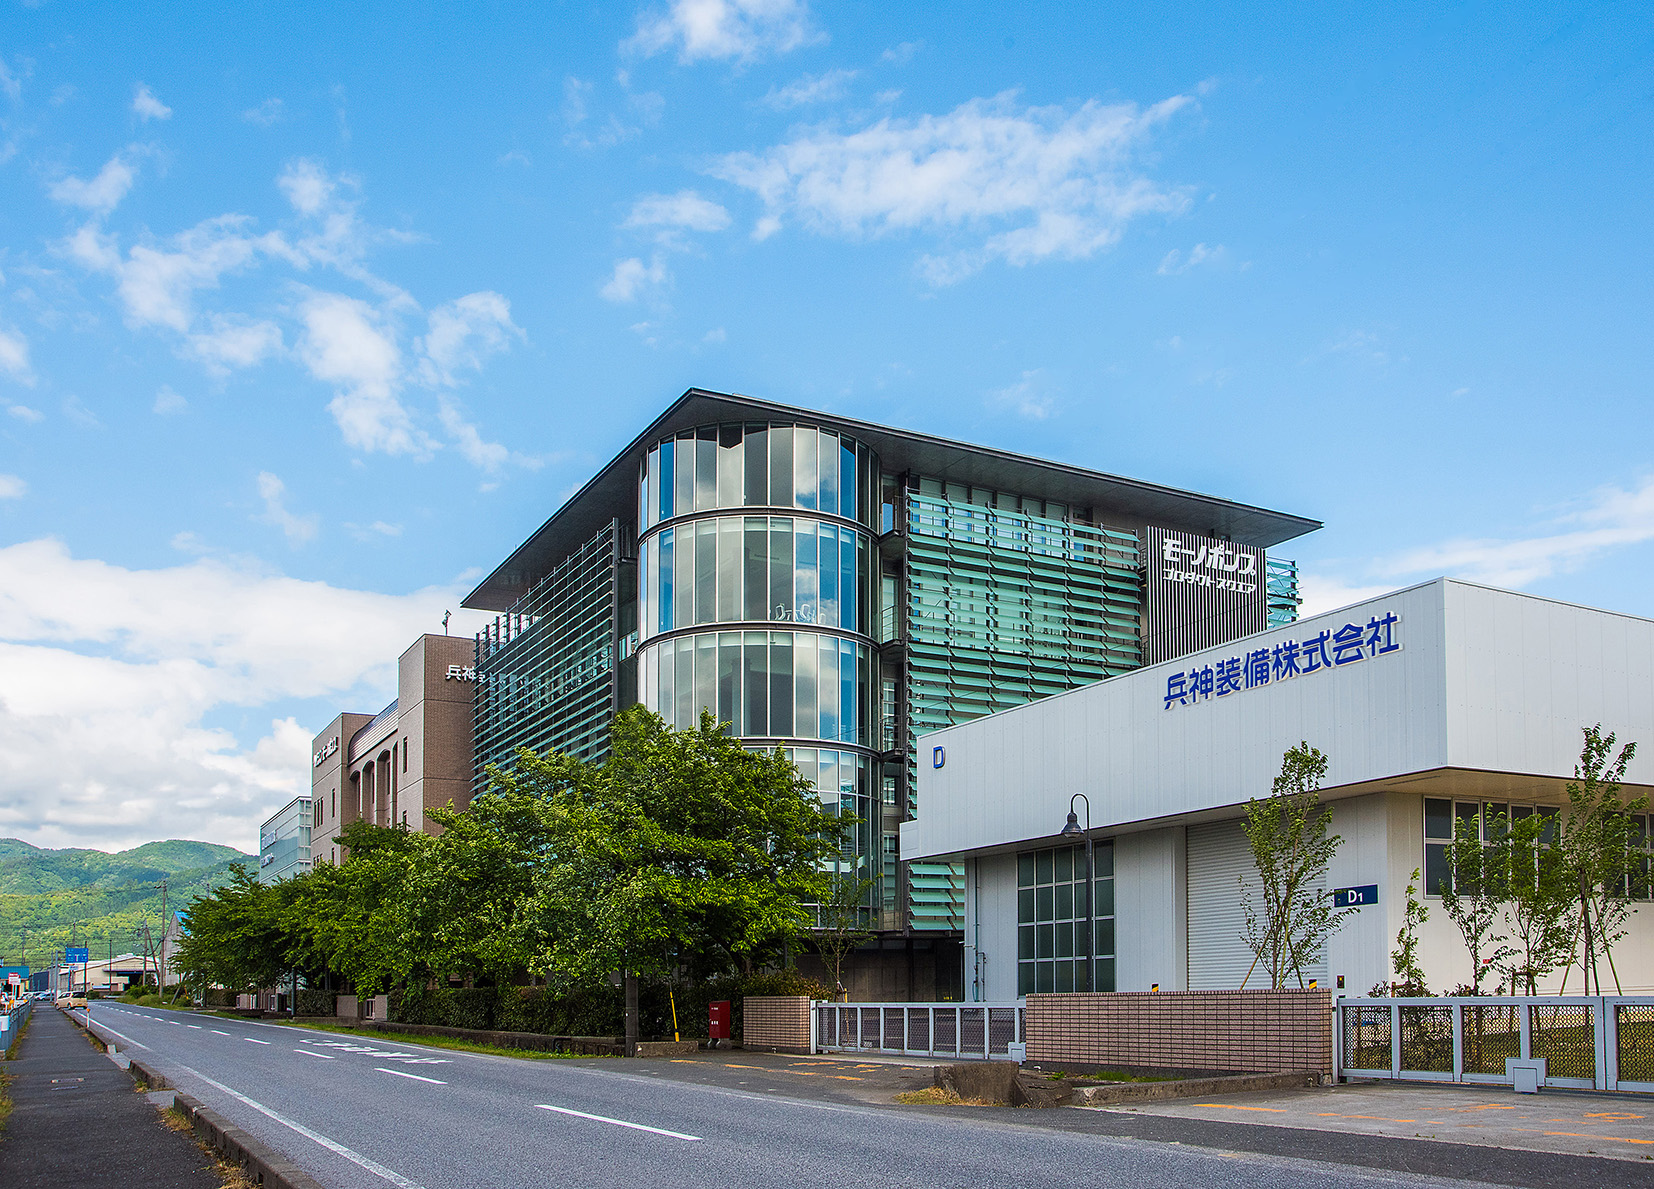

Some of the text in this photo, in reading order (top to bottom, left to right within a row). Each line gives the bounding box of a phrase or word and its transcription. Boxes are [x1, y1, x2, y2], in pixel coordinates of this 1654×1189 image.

[1162, 538, 1256, 576] モーノポンプ
[1163, 611, 1401, 710] 兵神装備株式会社
[933, 746, 945, 768] D
[1347, 890, 1363, 903] D1
